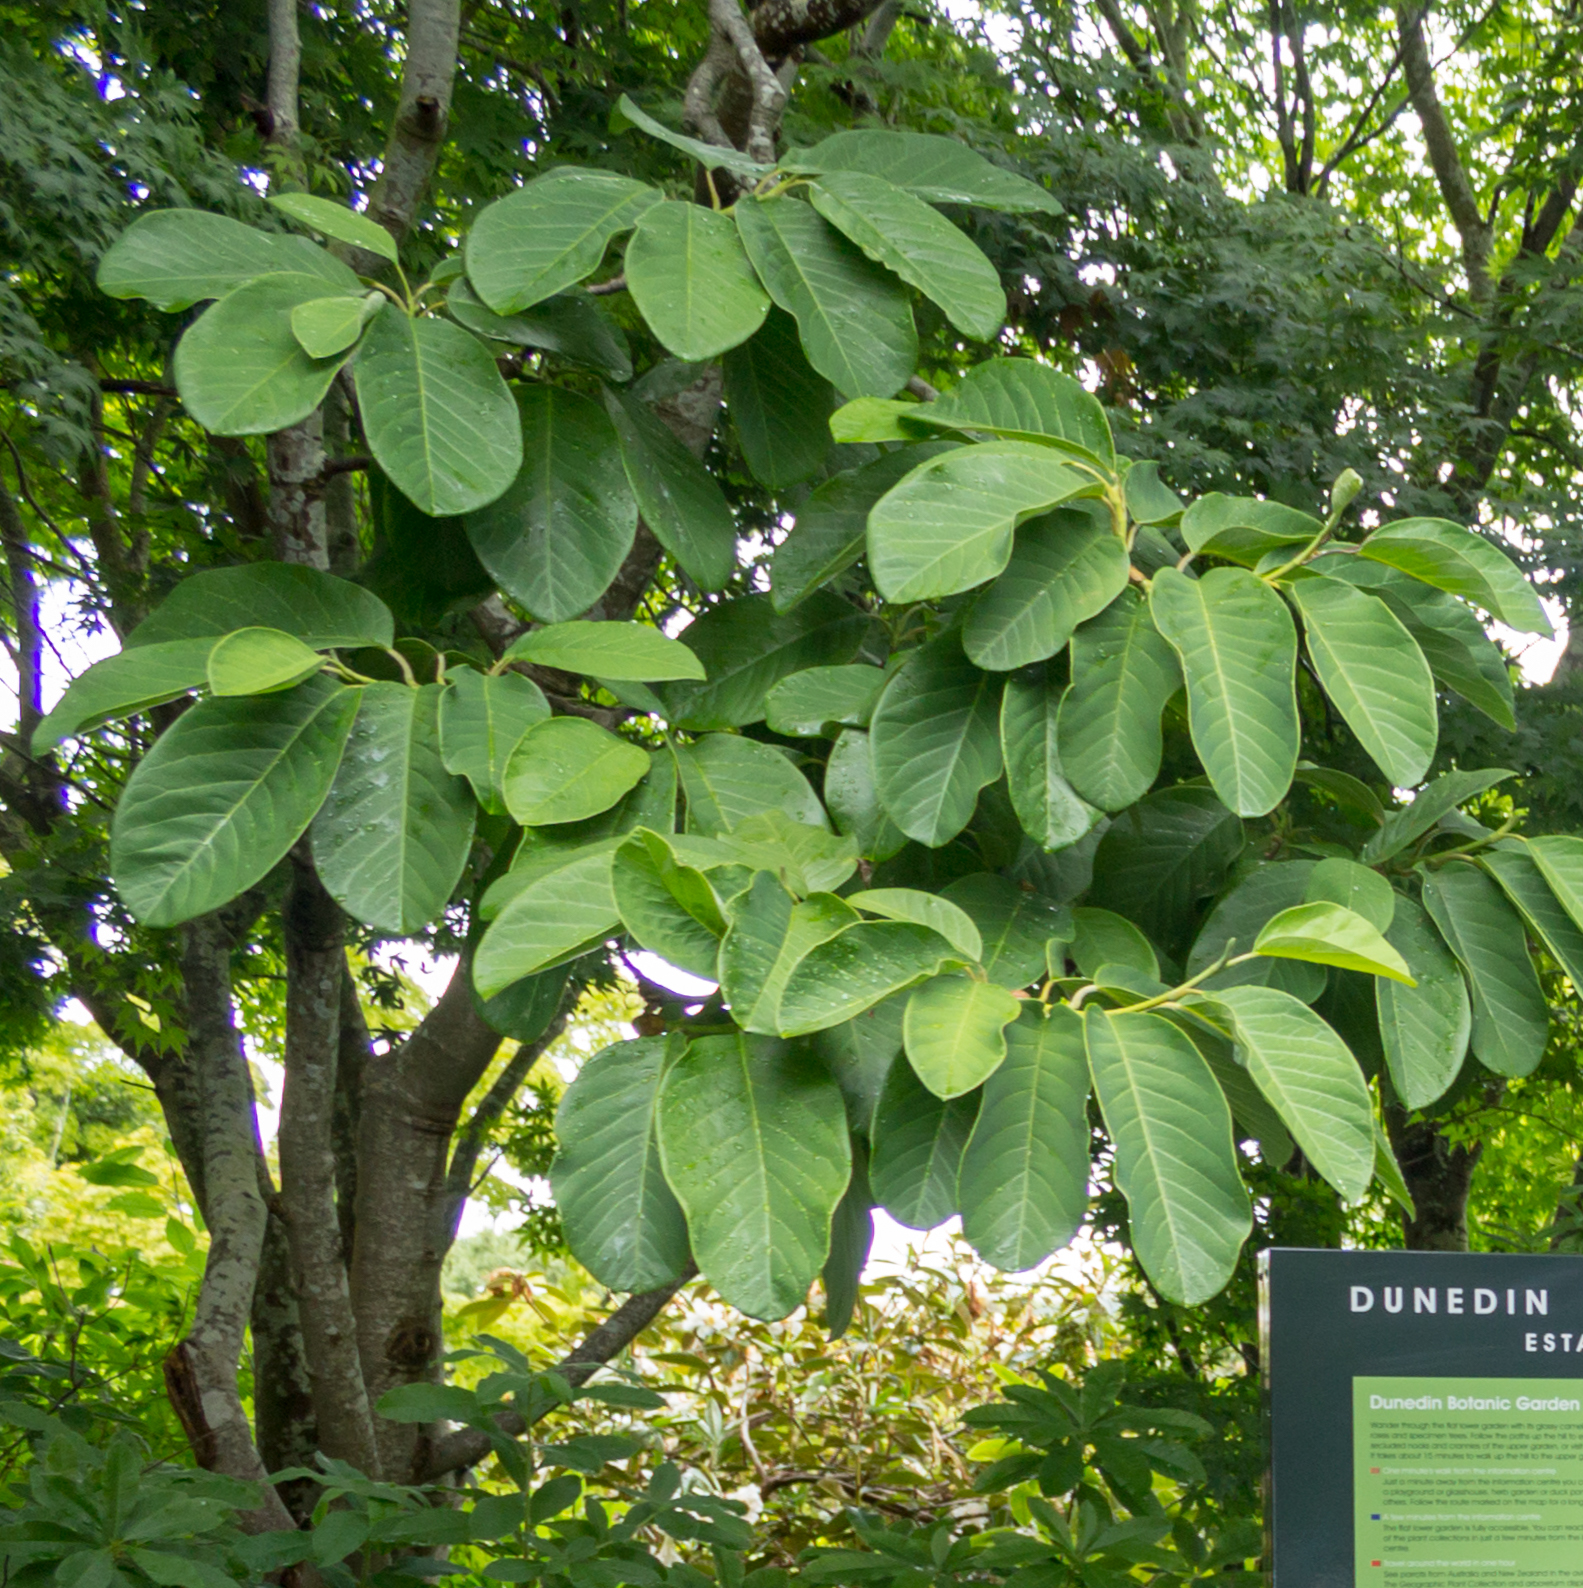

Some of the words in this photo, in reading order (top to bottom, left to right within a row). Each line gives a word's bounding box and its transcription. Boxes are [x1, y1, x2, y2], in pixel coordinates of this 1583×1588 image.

[1350, 1286, 1547, 1315] DUNEDIN
[1369, 1394, 1442, 1410] Dunedin
[1446, 1395, 1512, 1410] Botanic
[1515, 1396, 1581, 1412] Garden
[1400, 1422, 1428, 1430] through
[1481, 1423, 1508, 1431] garden
[1508, 1433, 1530, 1441] paths
[1434, 1524, 1462, 1532] garden
